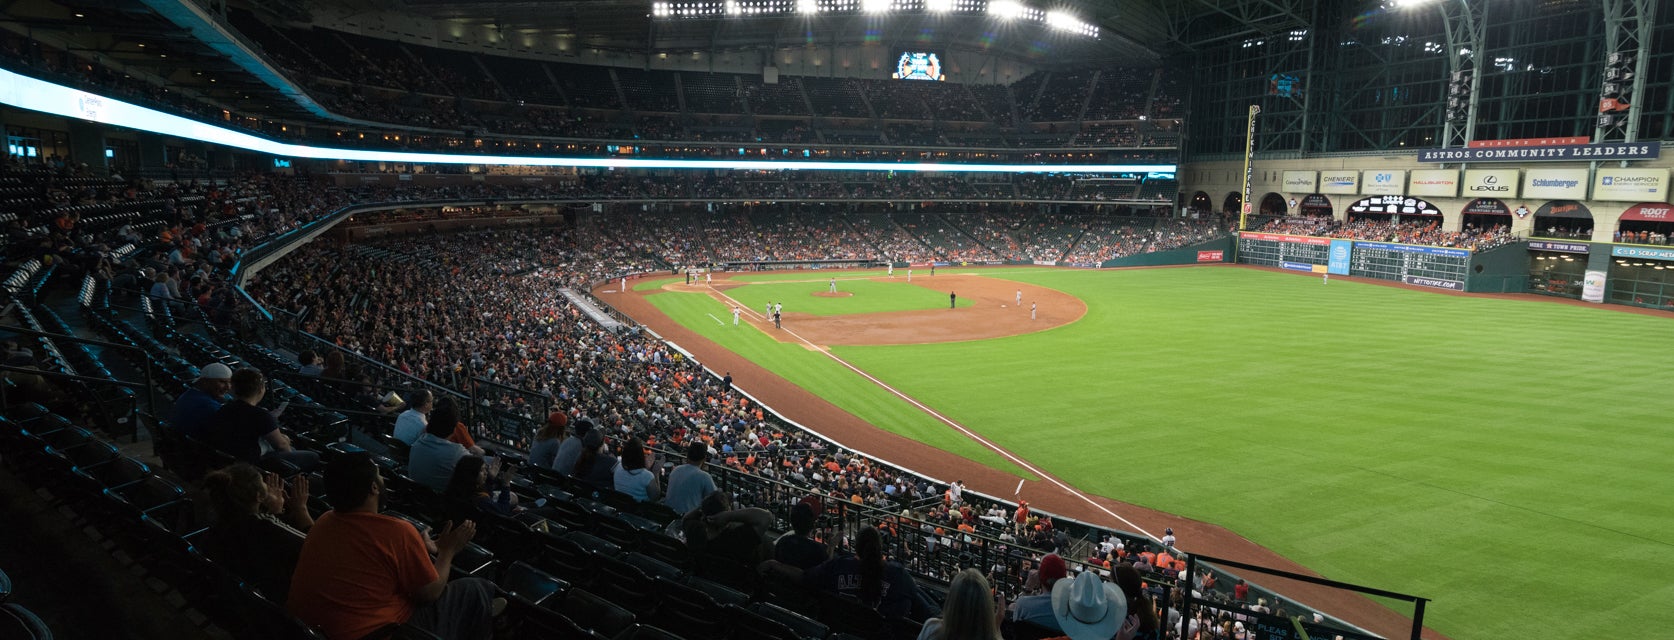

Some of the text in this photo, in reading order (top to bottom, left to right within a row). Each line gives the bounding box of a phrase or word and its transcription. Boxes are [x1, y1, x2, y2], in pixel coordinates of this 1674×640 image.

[1425, 146, 1649, 159] ASTROS COMMUNITY LEADERS
[1532, 179, 1578, 188] Schlumberger
[1639, 207, 1670, 216] ROOT
